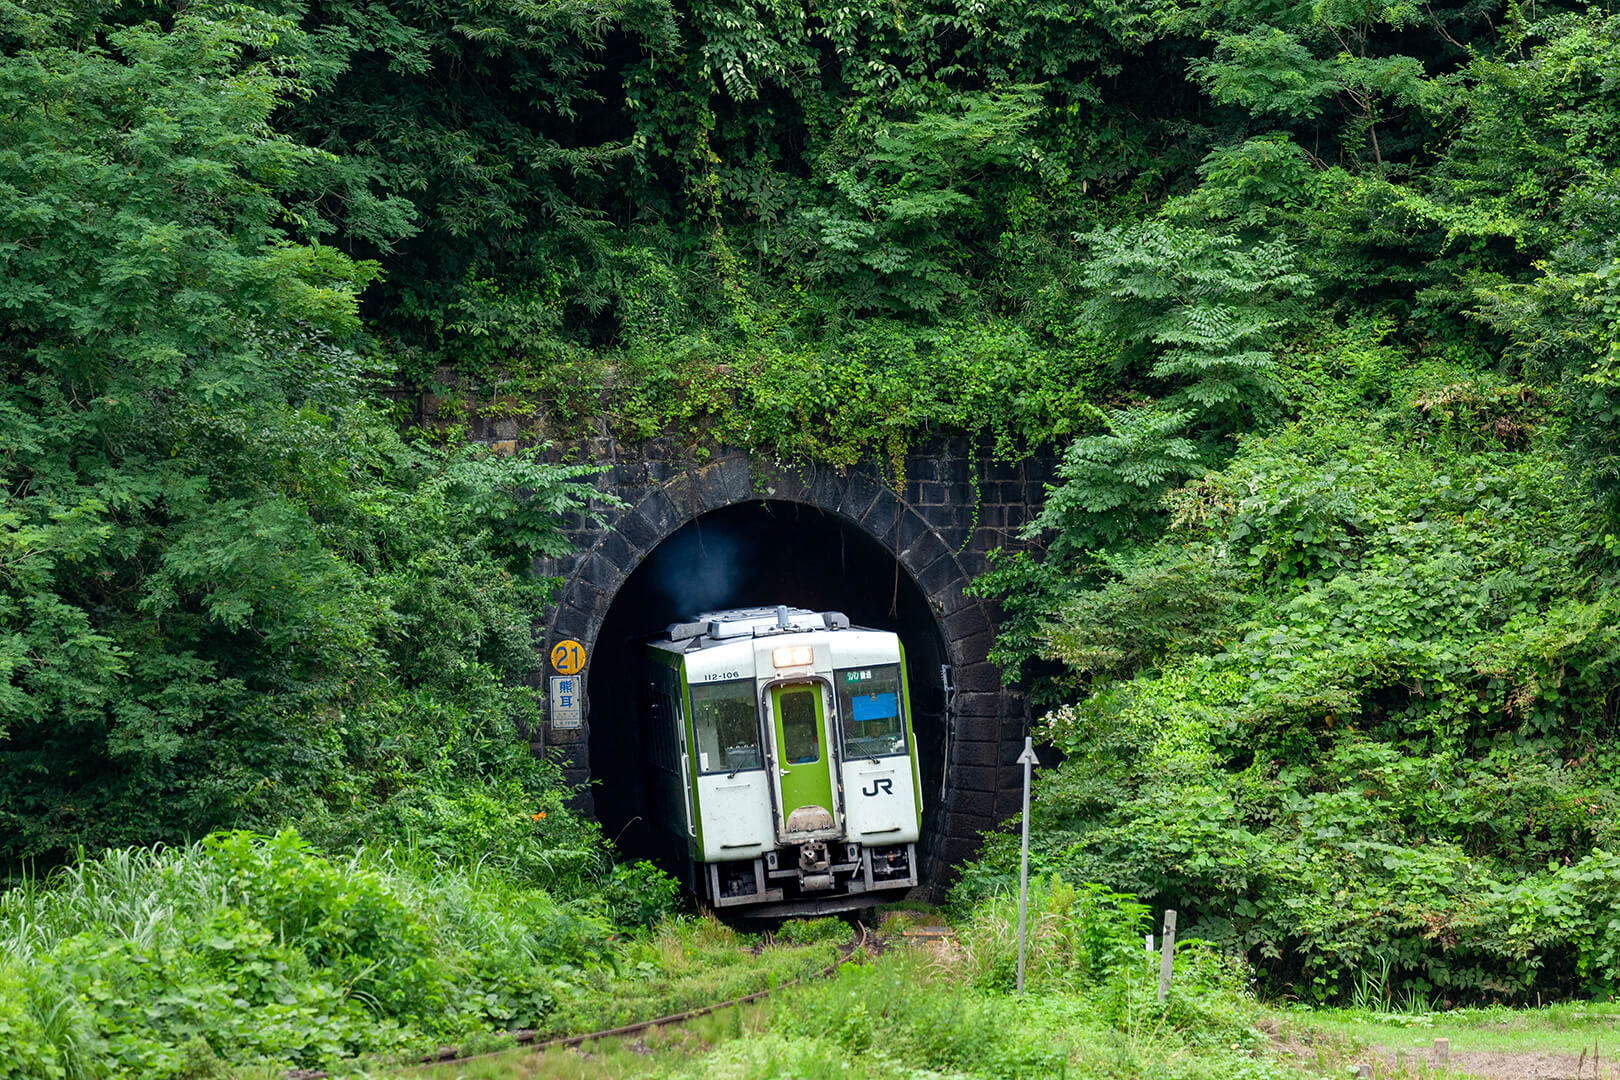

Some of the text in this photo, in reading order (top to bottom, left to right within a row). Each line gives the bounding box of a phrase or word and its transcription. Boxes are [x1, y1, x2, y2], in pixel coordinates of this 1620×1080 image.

[556, 646, 578, 669] 21
[704, 671, 740, 681] 112-106
[559, 680, 573, 708] 熊耳
[862, 778, 893, 797] JR
